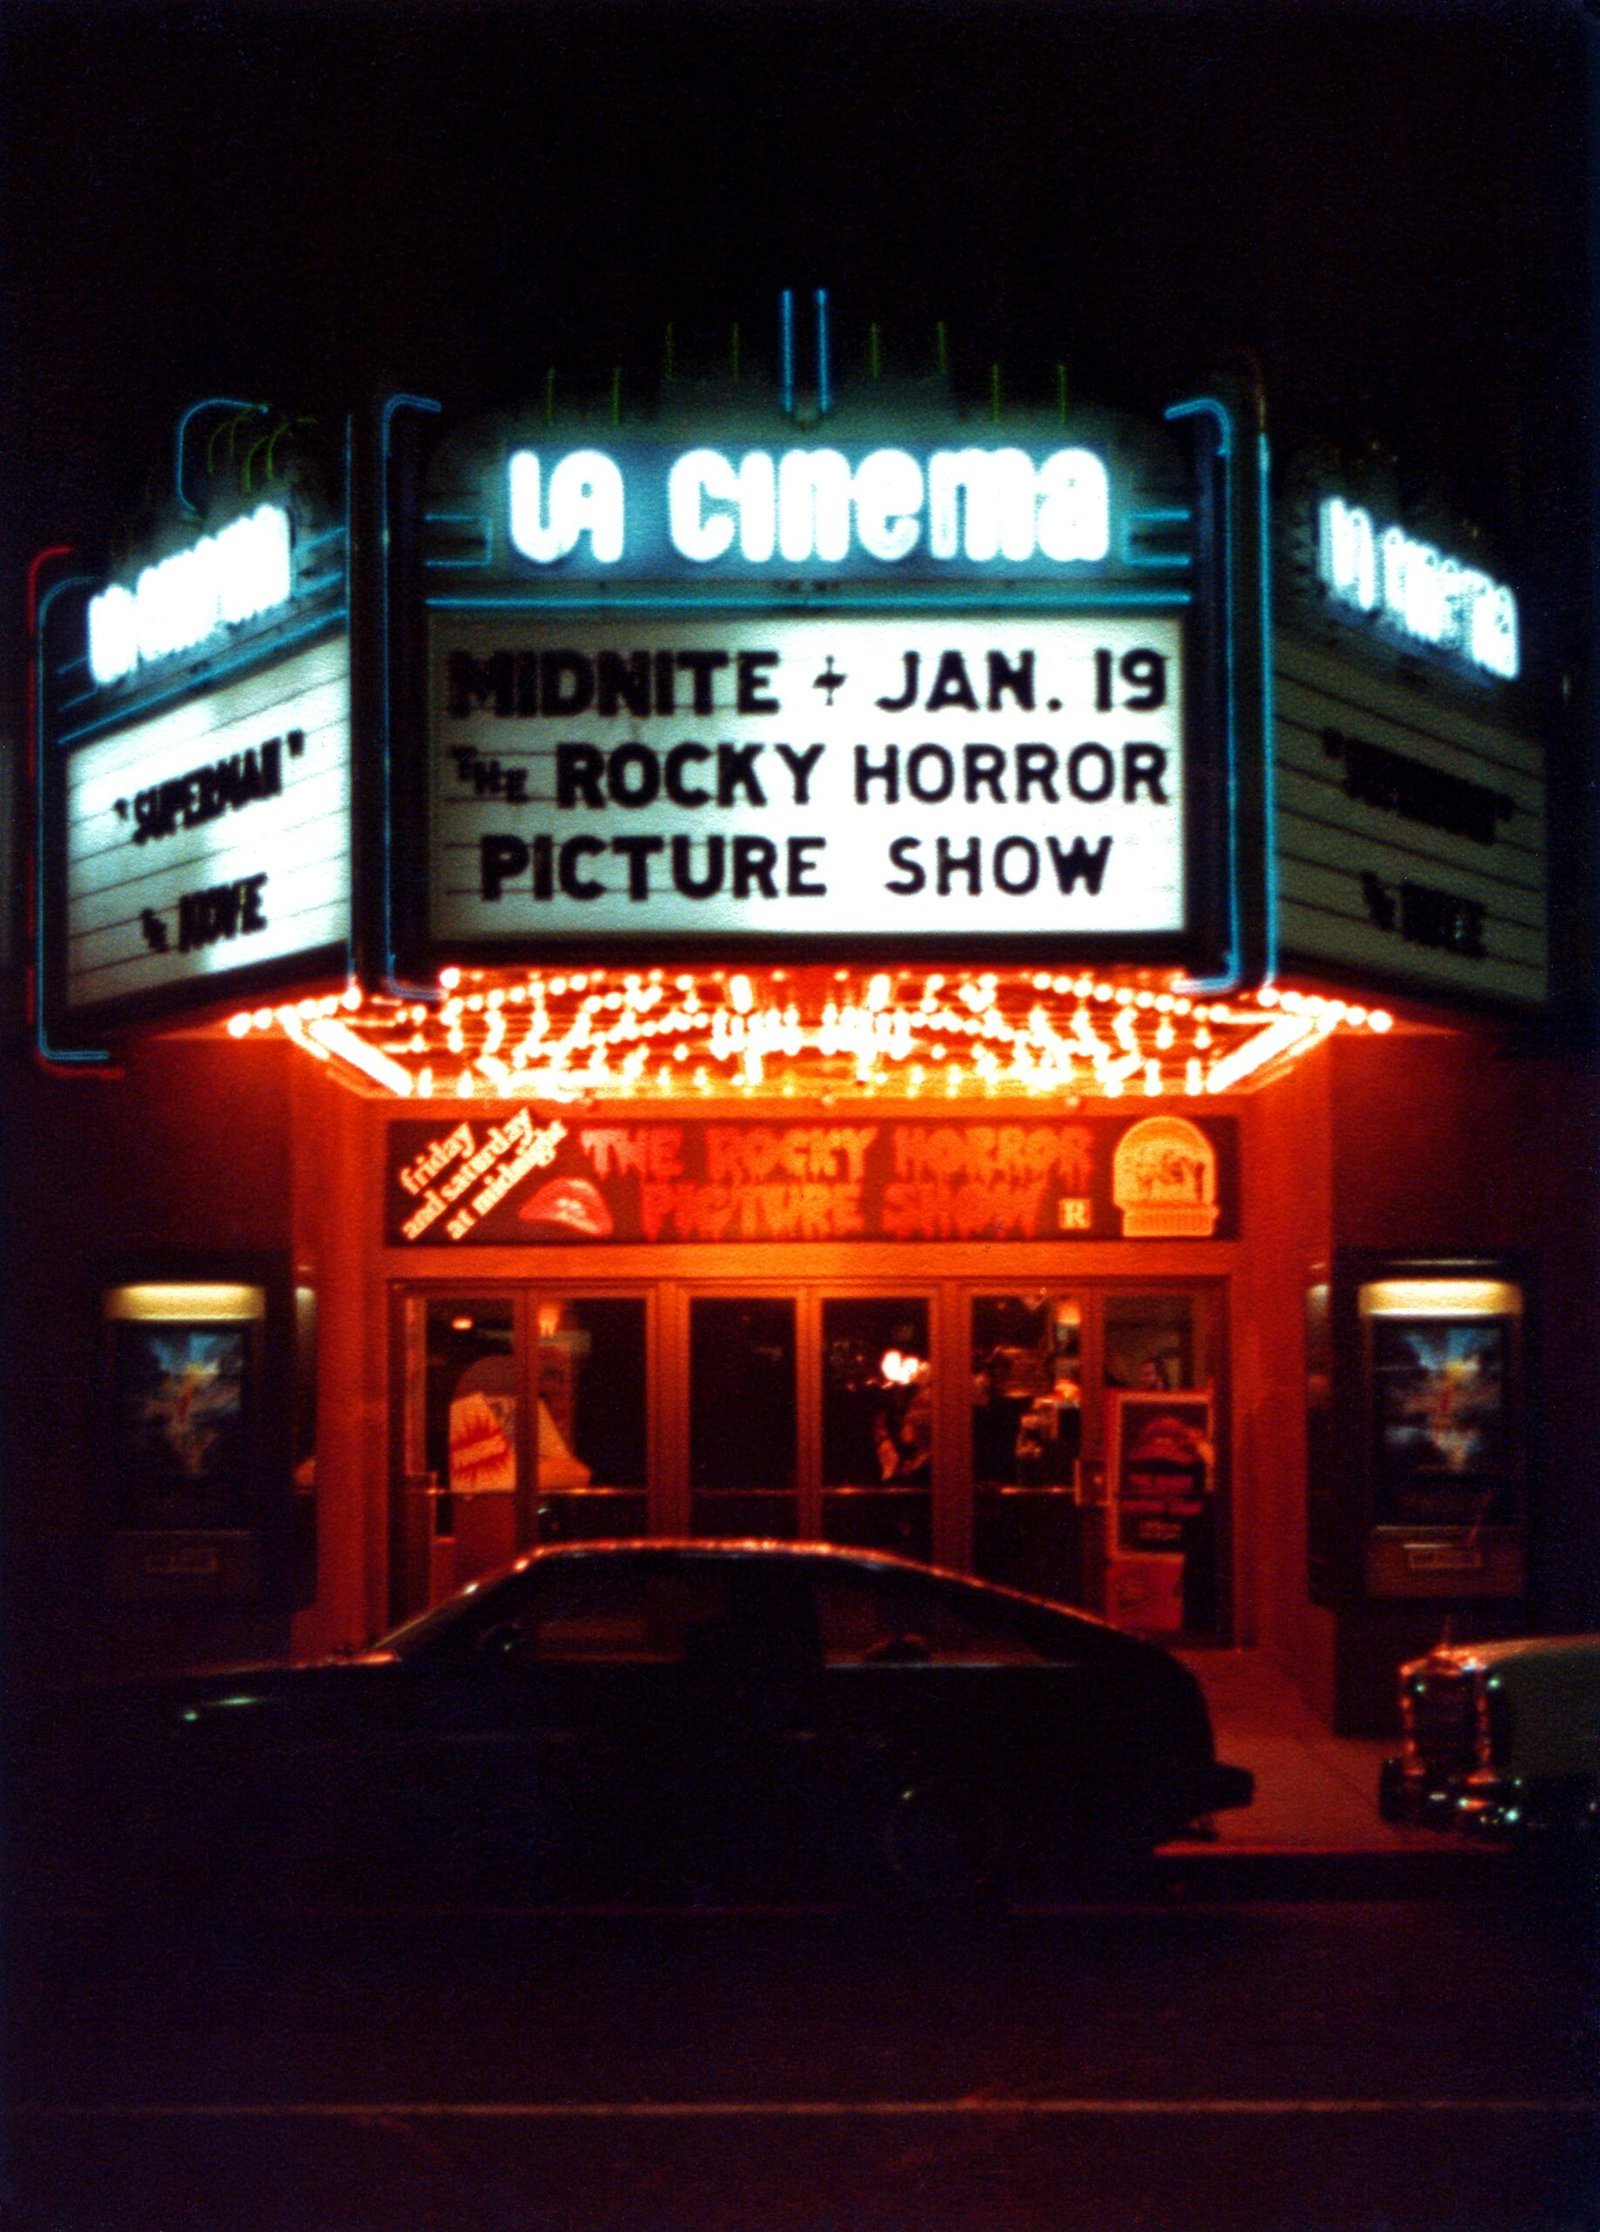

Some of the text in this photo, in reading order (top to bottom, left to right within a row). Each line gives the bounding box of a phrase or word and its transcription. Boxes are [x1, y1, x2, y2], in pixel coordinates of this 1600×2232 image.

[448, 650, 781, 718] MIDNITE
[876, 650, 1064, 712] JAN.
[1095, 648, 1168, 711] 19
[556, 742, 825, 809] ROCKY
[854, 742, 1170, 805] HORROR
[479, 835, 1113, 901] PICTURE SHOW
[399, 1122, 476, 1195] friday
[402, 1106, 534, 1240] and saturday
[446, 1119, 568, 1240] at midnight
[580, 1128, 684, 1181] THE
[706, 1126, 878, 1184] ROCKY
[893, 1126, 1095, 1187] HORROR
[641, 1183, 1049, 1238] PICTURE SHOW
